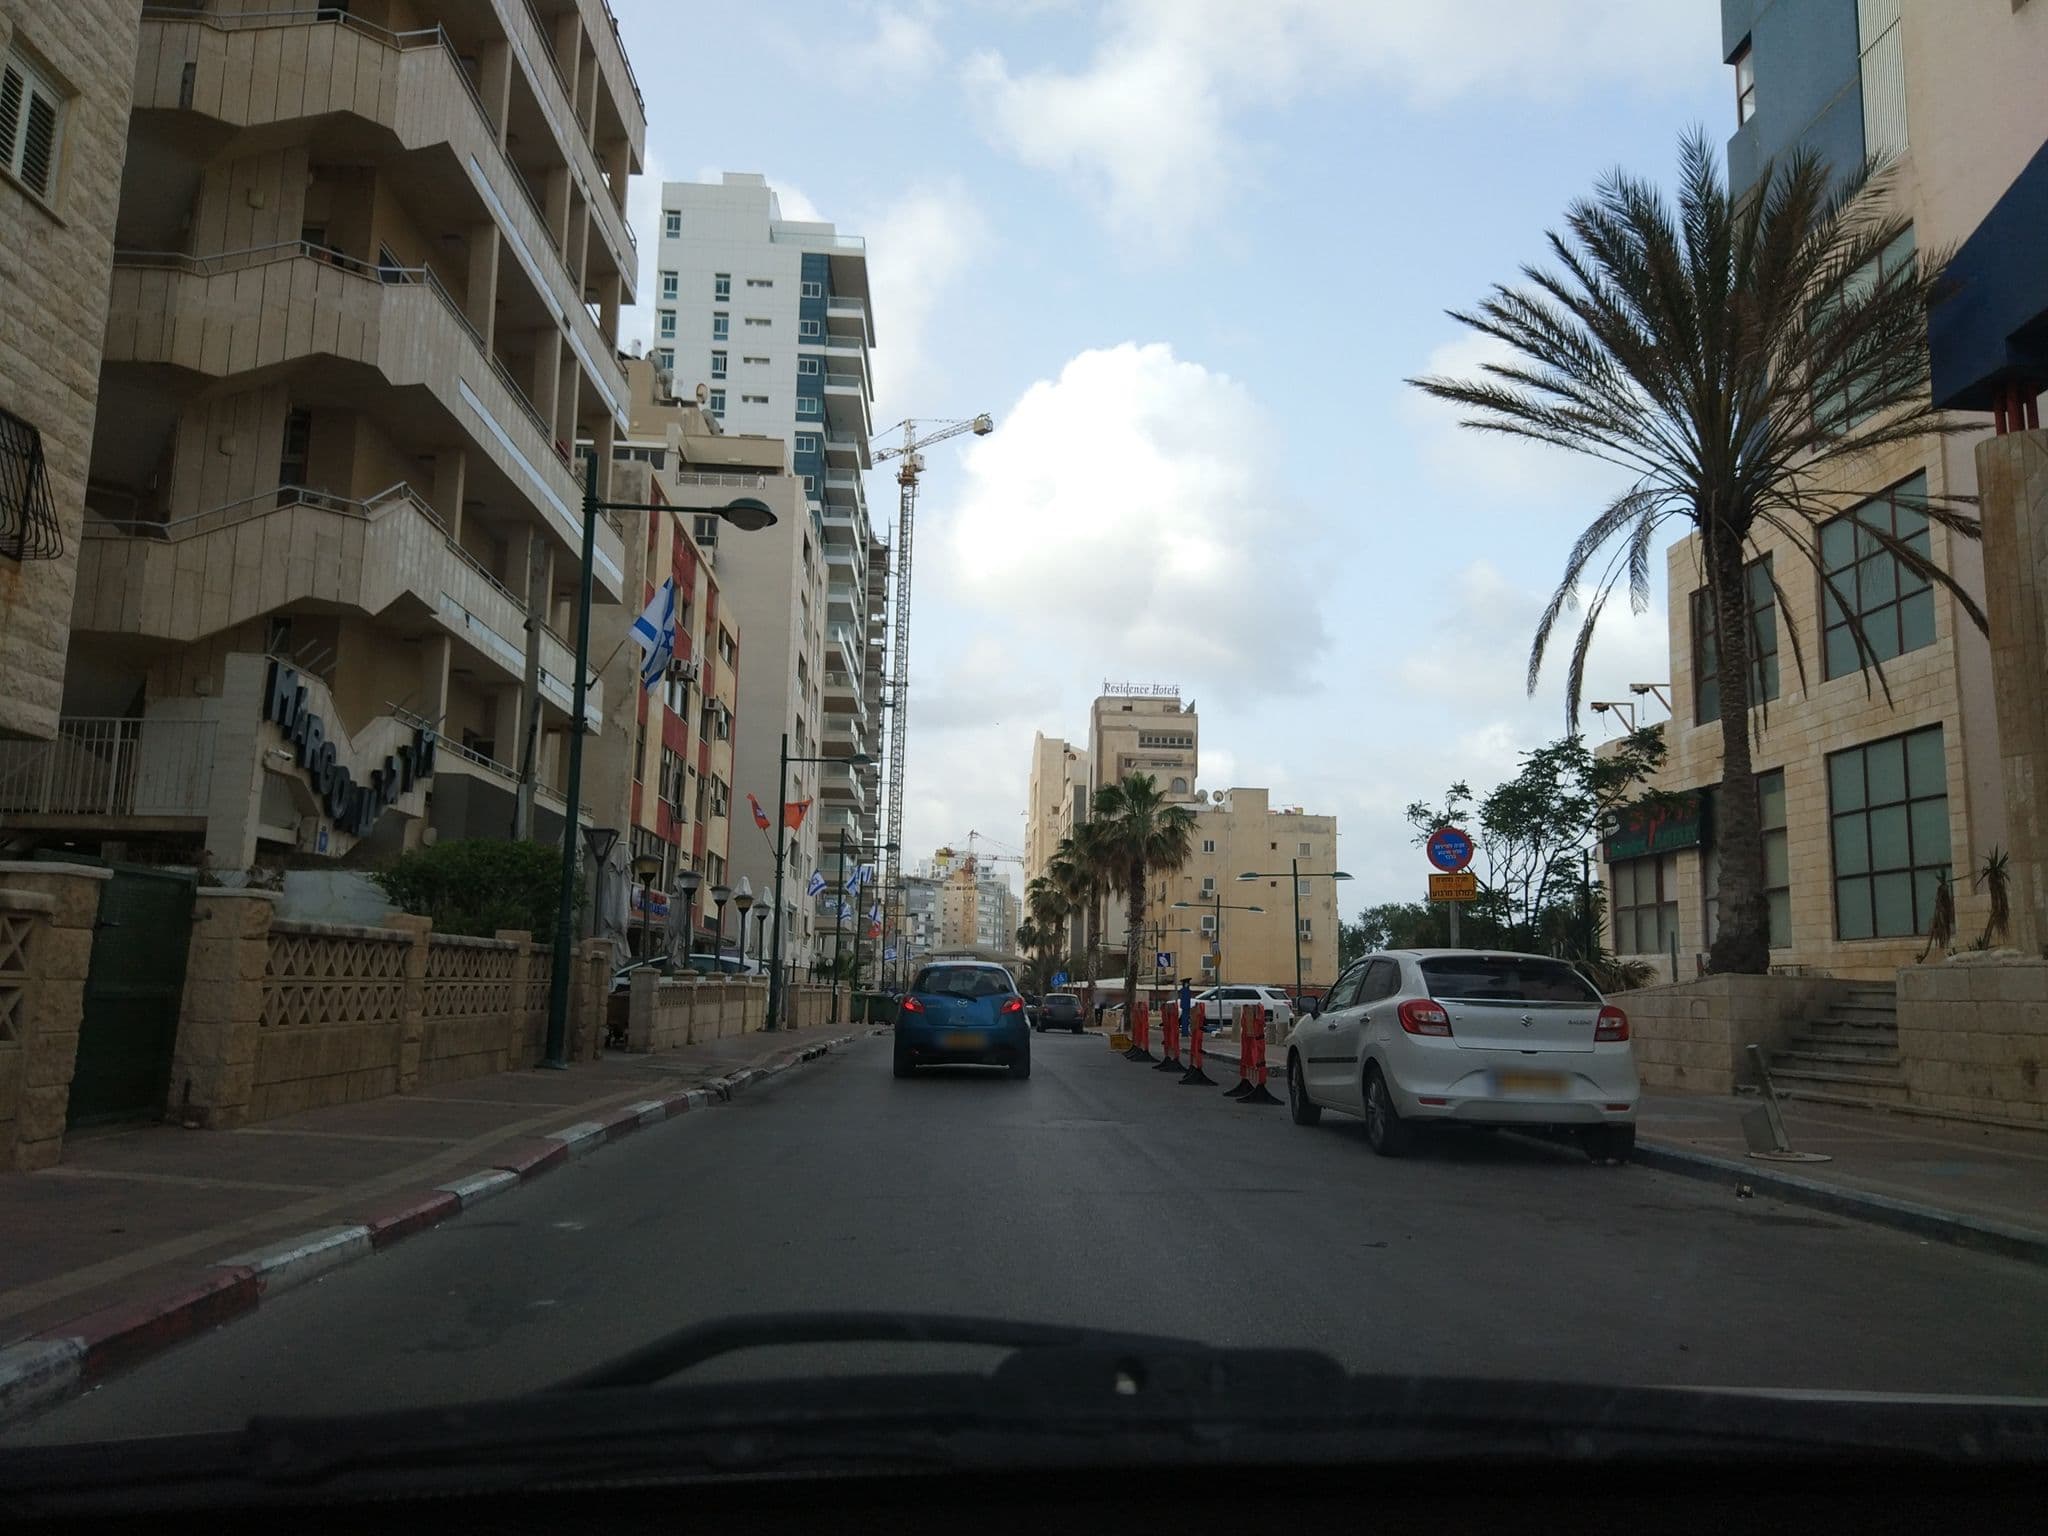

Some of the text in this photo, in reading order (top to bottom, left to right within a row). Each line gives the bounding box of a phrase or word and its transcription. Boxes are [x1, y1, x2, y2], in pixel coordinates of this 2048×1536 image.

[1104, 683, 1180, 695] Residence Hotels
[263, 662, 361, 836] MARGO
